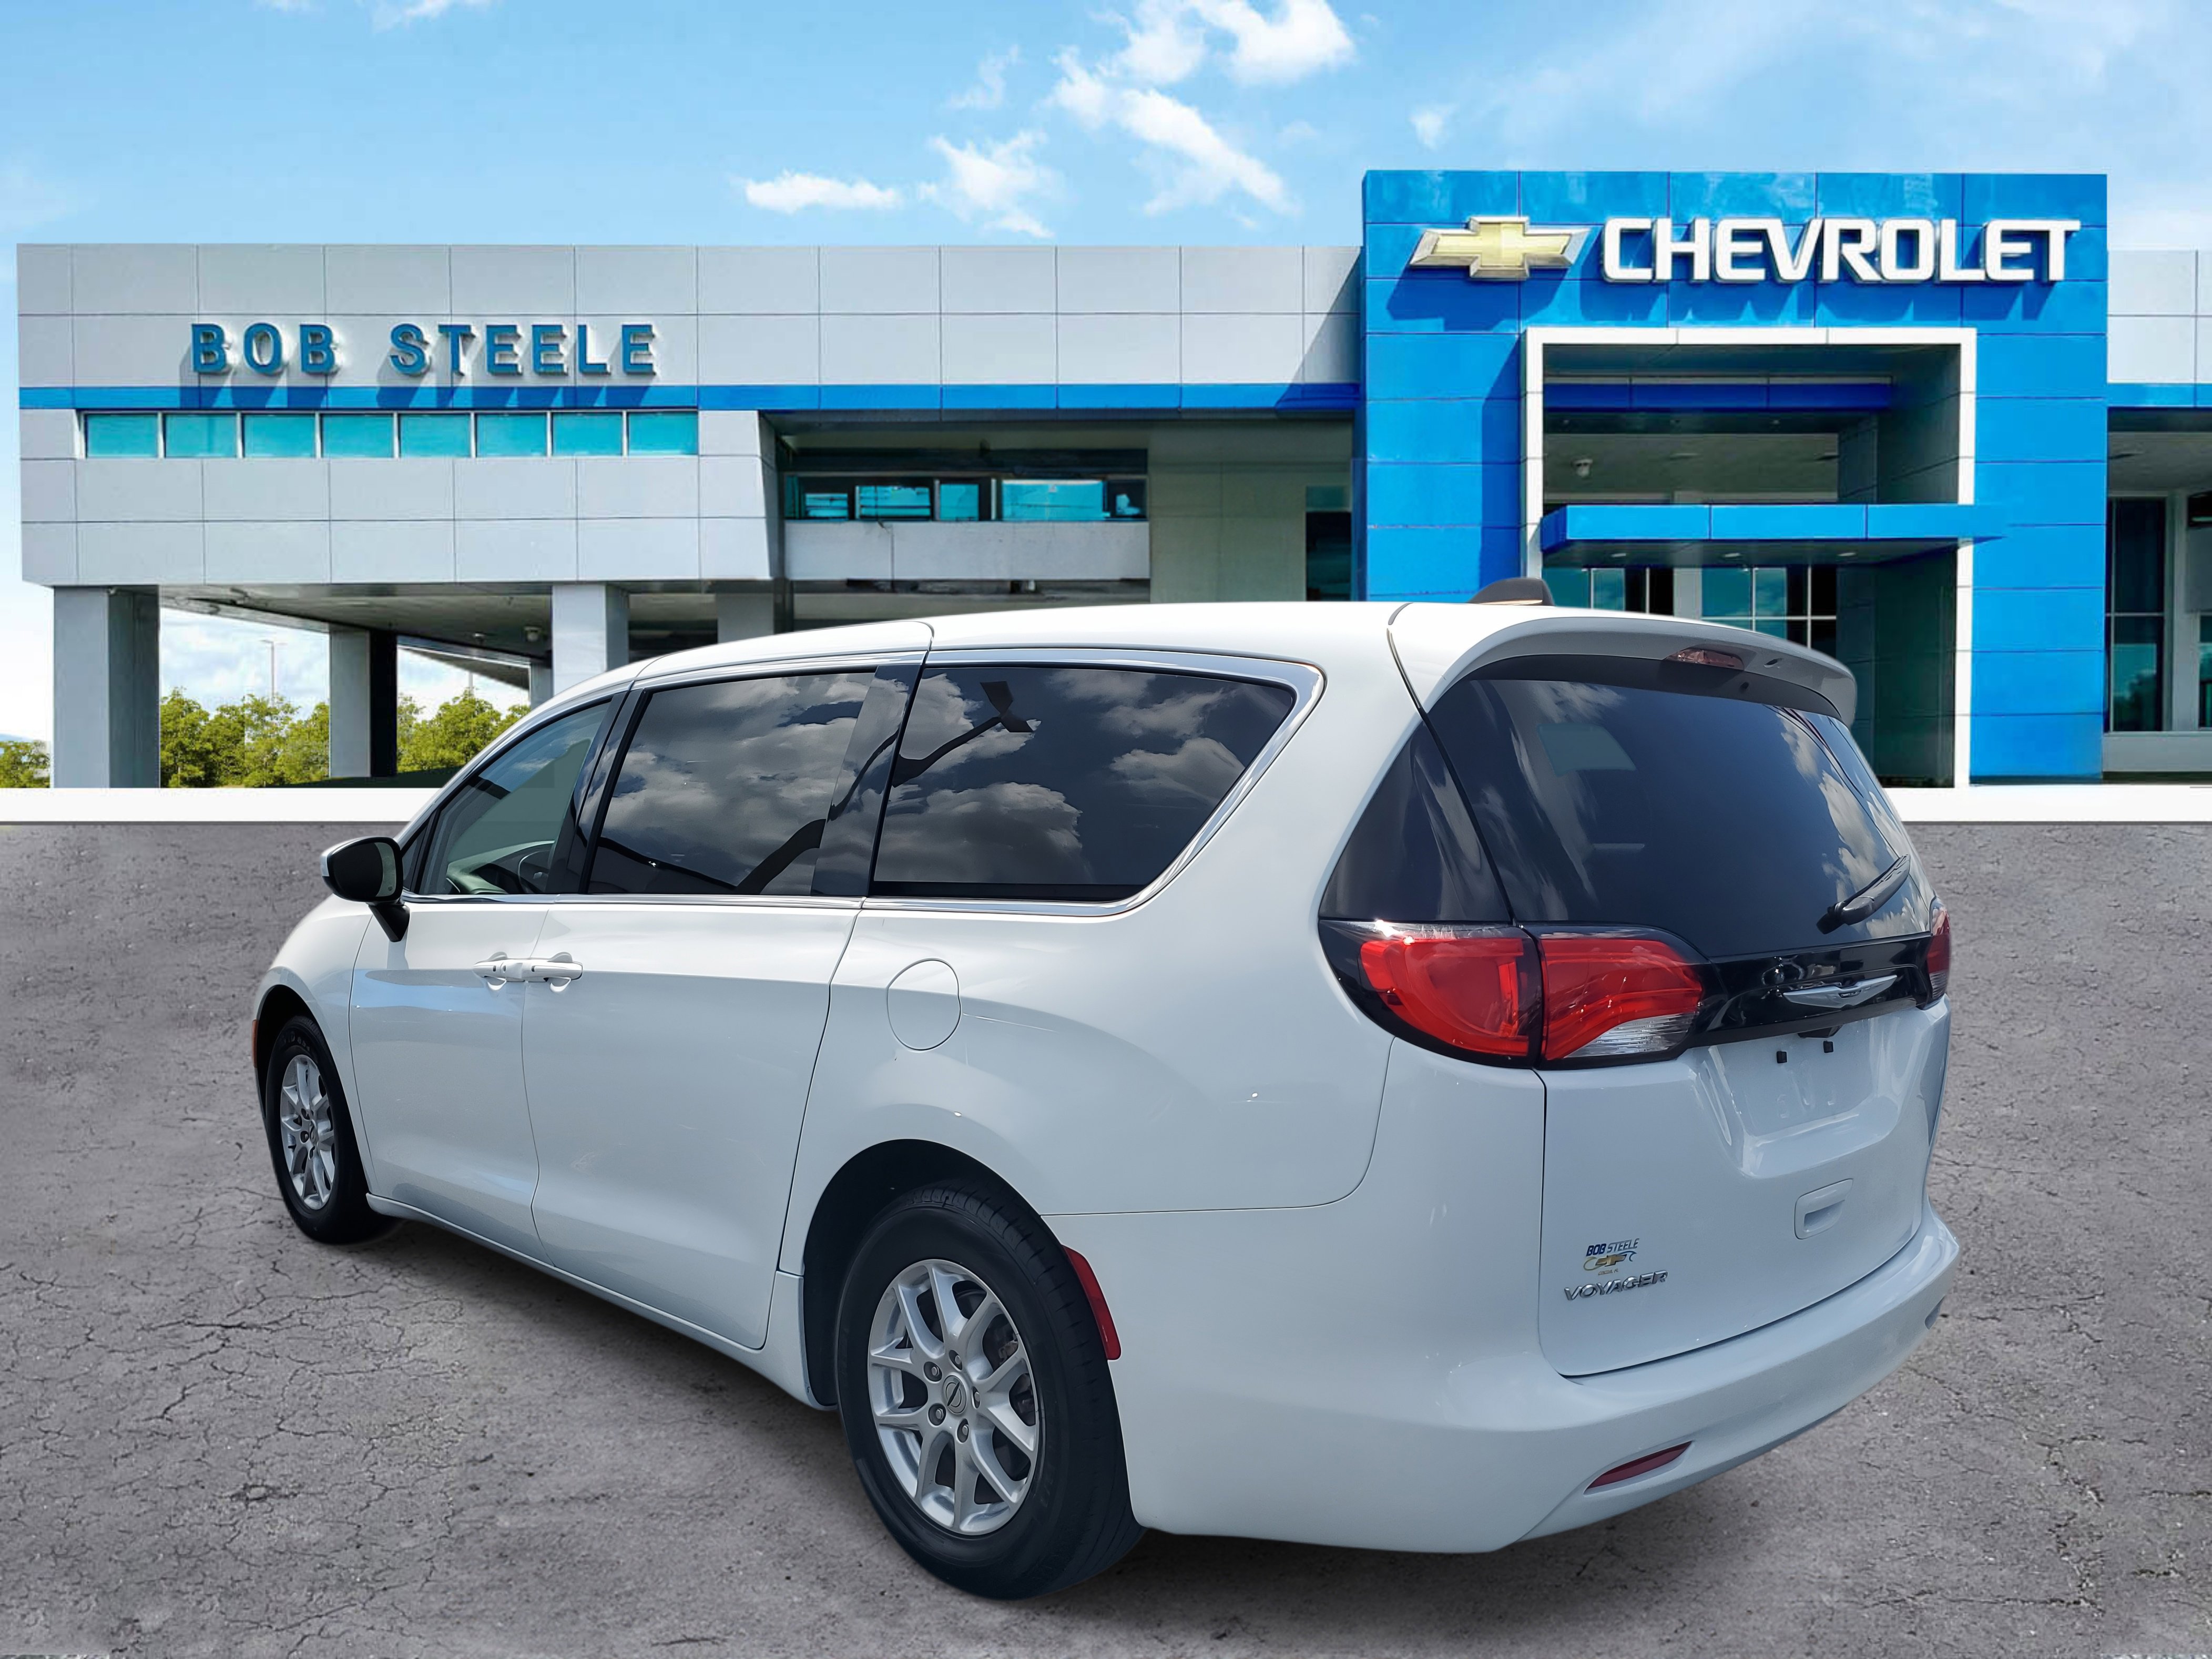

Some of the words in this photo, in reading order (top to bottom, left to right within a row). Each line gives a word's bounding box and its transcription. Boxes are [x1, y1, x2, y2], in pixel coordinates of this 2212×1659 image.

[1602, 217, 2081, 284] CHEVROLET
[191, 322, 338, 375] BOB
[390, 322, 656, 375] STEELE
[1586, 1243, 1606, 1257] BOB
[1607, 1238, 1640, 1253] STEELE
[1564, 1269, 1668, 1301] VOYAGER
